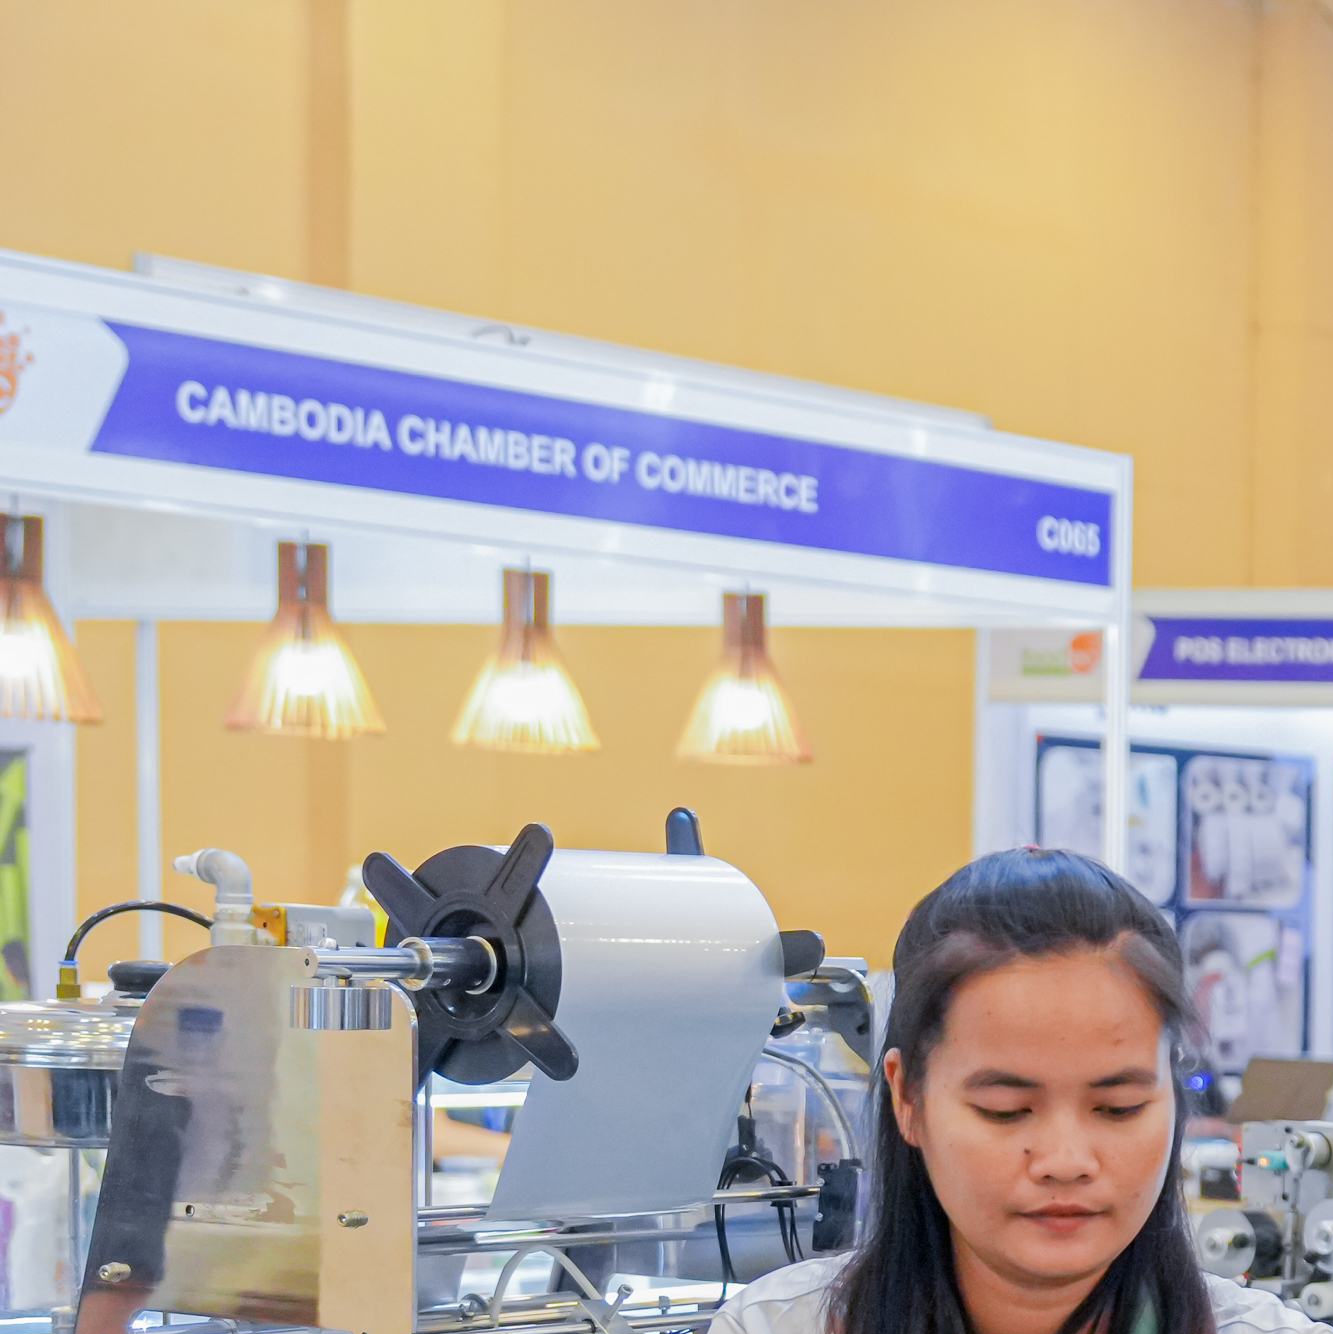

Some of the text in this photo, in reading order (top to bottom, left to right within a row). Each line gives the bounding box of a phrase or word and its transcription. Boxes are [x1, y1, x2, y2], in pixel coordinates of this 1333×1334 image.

[175, 380, 818, 514] CAMBODIA CHAMBER OF COMMERCE
[1037, 515, 1100, 557] C065
[1173, 637, 1223, 665] POS
